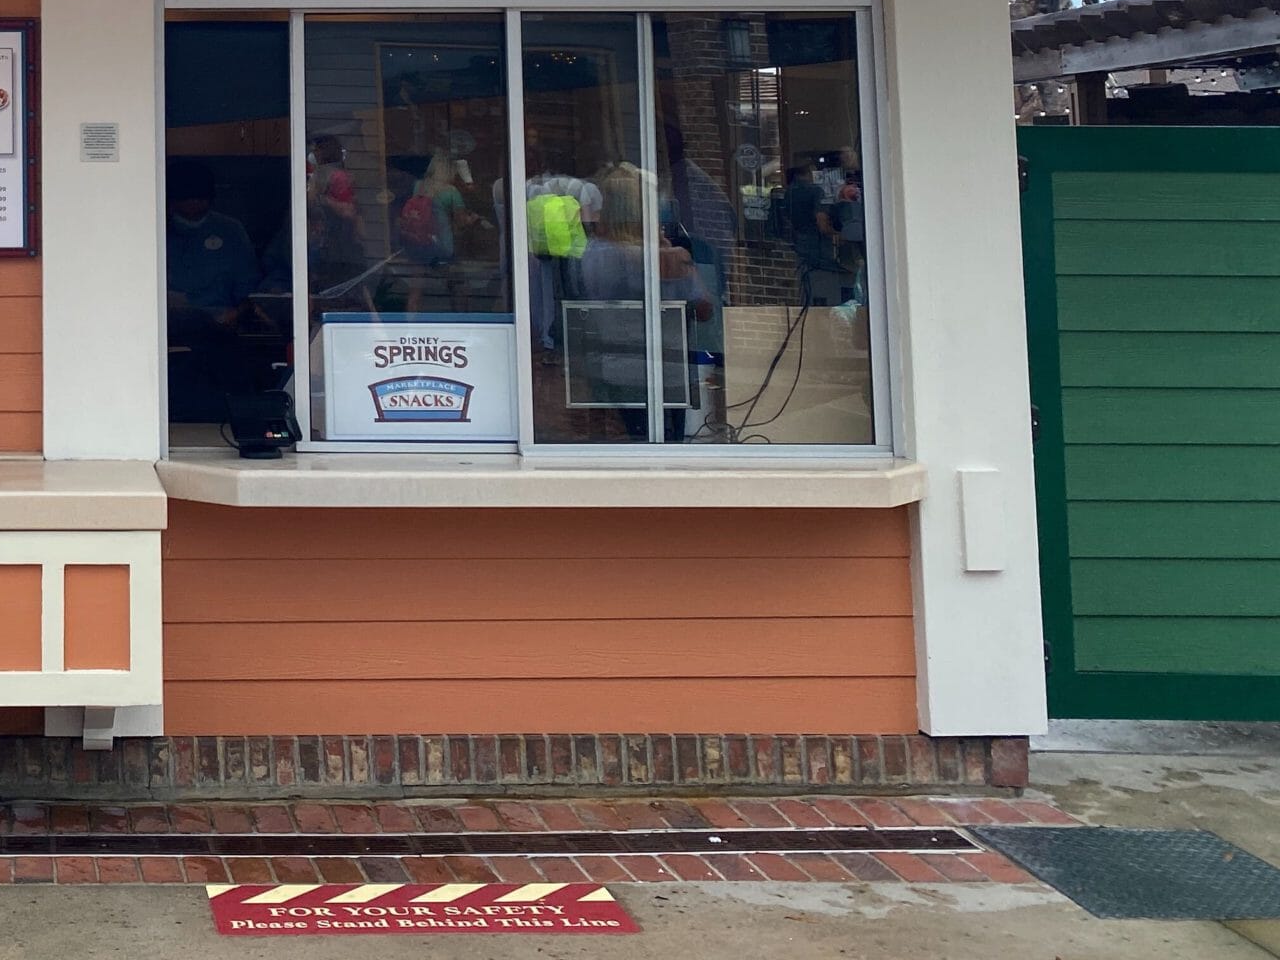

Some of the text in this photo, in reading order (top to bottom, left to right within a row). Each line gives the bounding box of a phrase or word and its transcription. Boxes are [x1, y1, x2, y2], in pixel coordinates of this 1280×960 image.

[374, 346, 468, 368] SPRINGS
[386, 380, 457, 391] MARKETPLACE
[389, 395, 453, 407] SNACKS
[268, 905, 564, 917] FOR YOUR SAFETY
[230, 917, 620, 929] Please Stand Behind This Line
